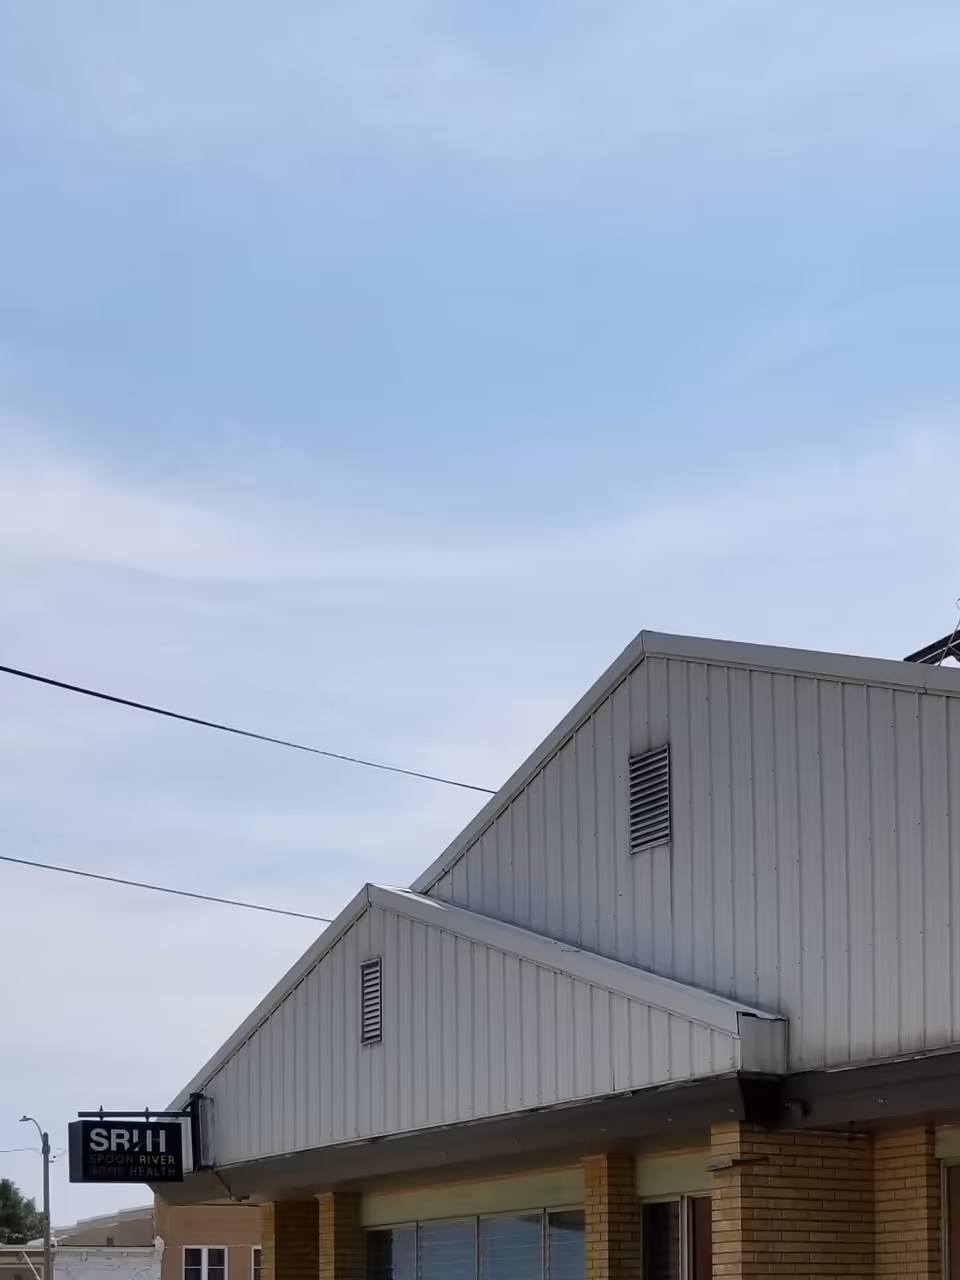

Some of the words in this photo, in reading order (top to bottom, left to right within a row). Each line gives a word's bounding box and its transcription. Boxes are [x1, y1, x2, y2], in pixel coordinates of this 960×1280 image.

[89, 1154, 133, 1164] SPOON
[140, 1155, 175, 1165] RIVER
[130, 1167, 176, 1177] HEALTH
